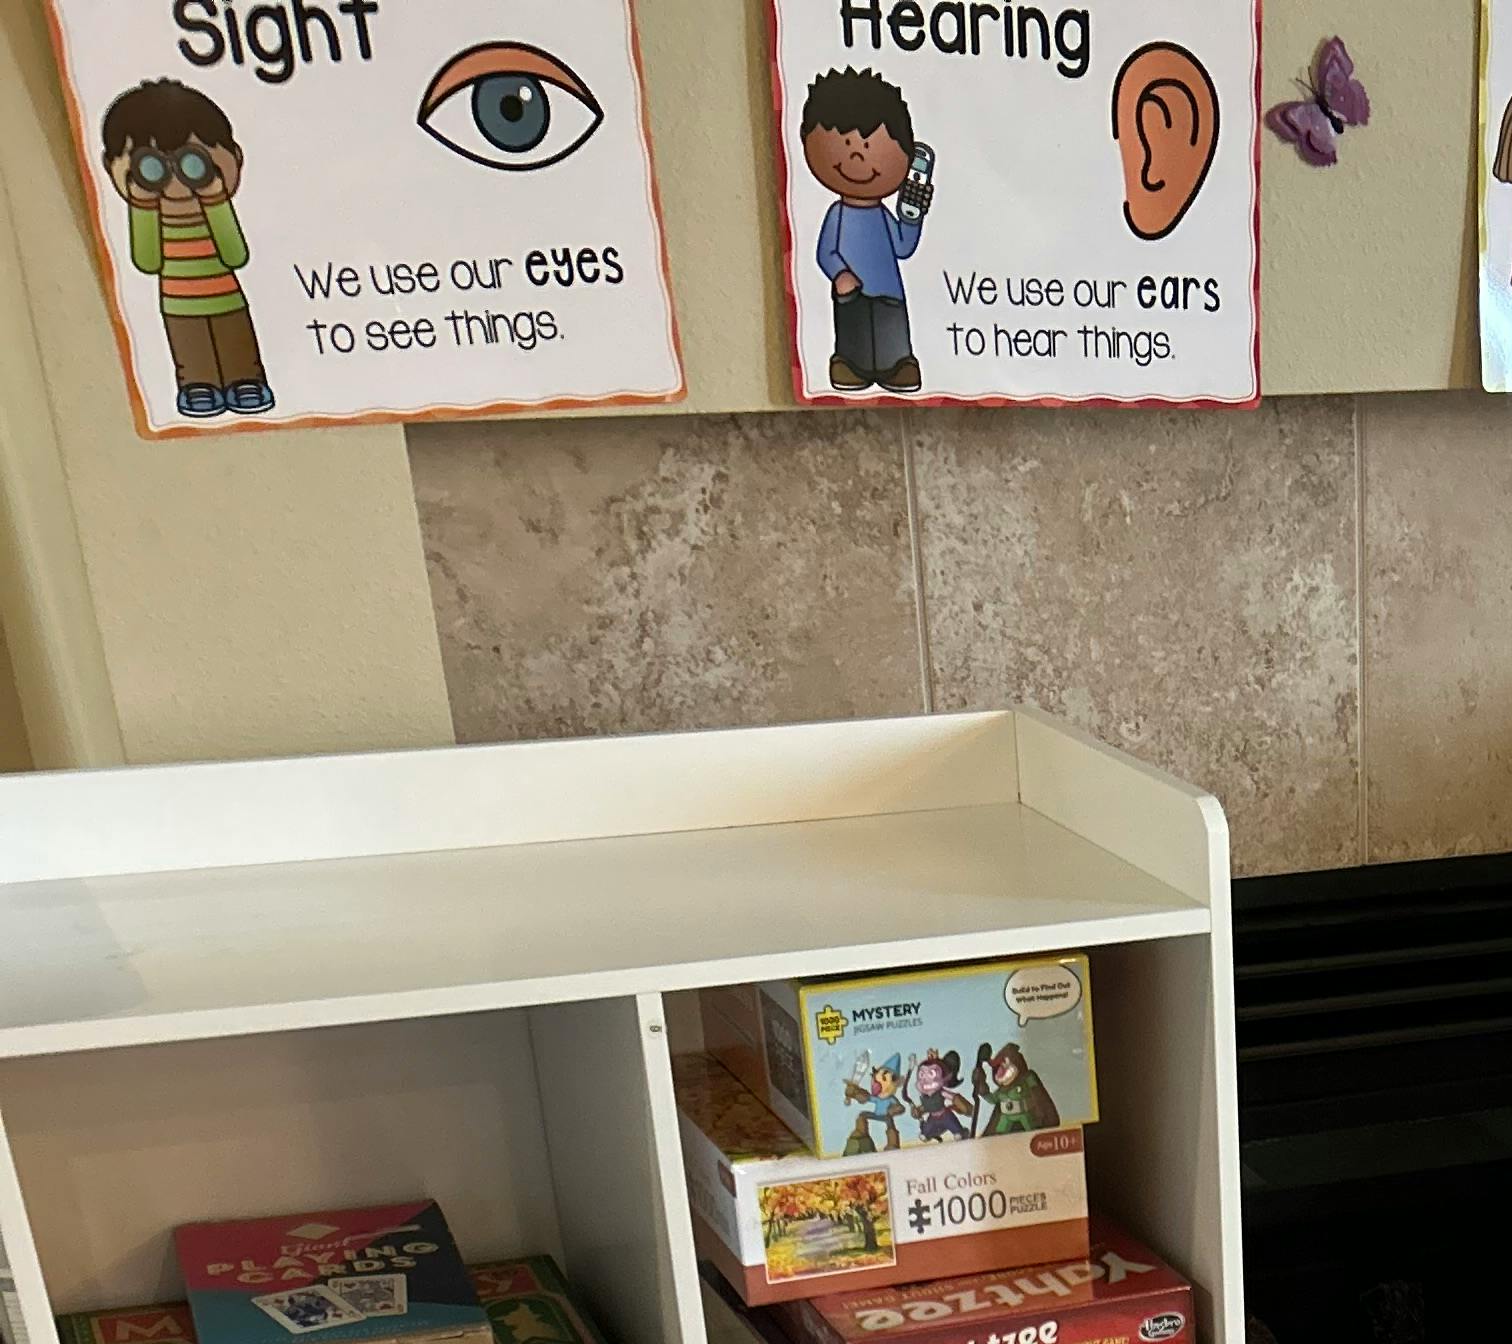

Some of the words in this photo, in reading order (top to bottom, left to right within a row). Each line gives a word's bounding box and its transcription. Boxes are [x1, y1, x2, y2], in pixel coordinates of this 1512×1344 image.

[172, 0, 378, 83] Sight
[841, 0, 1091, 79] Hearing
[294, 262, 361, 299] We
[370, 261, 440, 296] use
[450, 257, 513, 291] our
[525, 246, 624, 294] eyes
[943, 270, 998, 305] We
[1007, 277, 1064, 307] use
[1073, 280, 1127, 308] our
[1137, 276, 1221, 312] ears
[306, 319, 355, 355] to
[365, 318, 436, 351] see
[444, 309, 565, 350] things.
[946, 322, 985, 356] to
[995, 324, 1068, 358] hear
[1077, 325, 1175, 367] things.
[852, 1002, 920, 1022] MYSTERY
[853, 1024, 884, 1036] JIGSAW
[886, 1018, 923, 1030] PUZZLES
[906, 1177, 937, 1195] Fall
[944, 1172, 997, 1190] Colors
[1010, 1192, 1047, 1205] PIECES
[933, 1190, 1006, 1226] 1000
[1010, 1202, 1048, 1215] PUZZLE
[207, 1242, 439, 1276] PLAYING
[236, 1256, 417, 1284] CARDS
[855, 1252, 1156, 1332] Yahtzee
